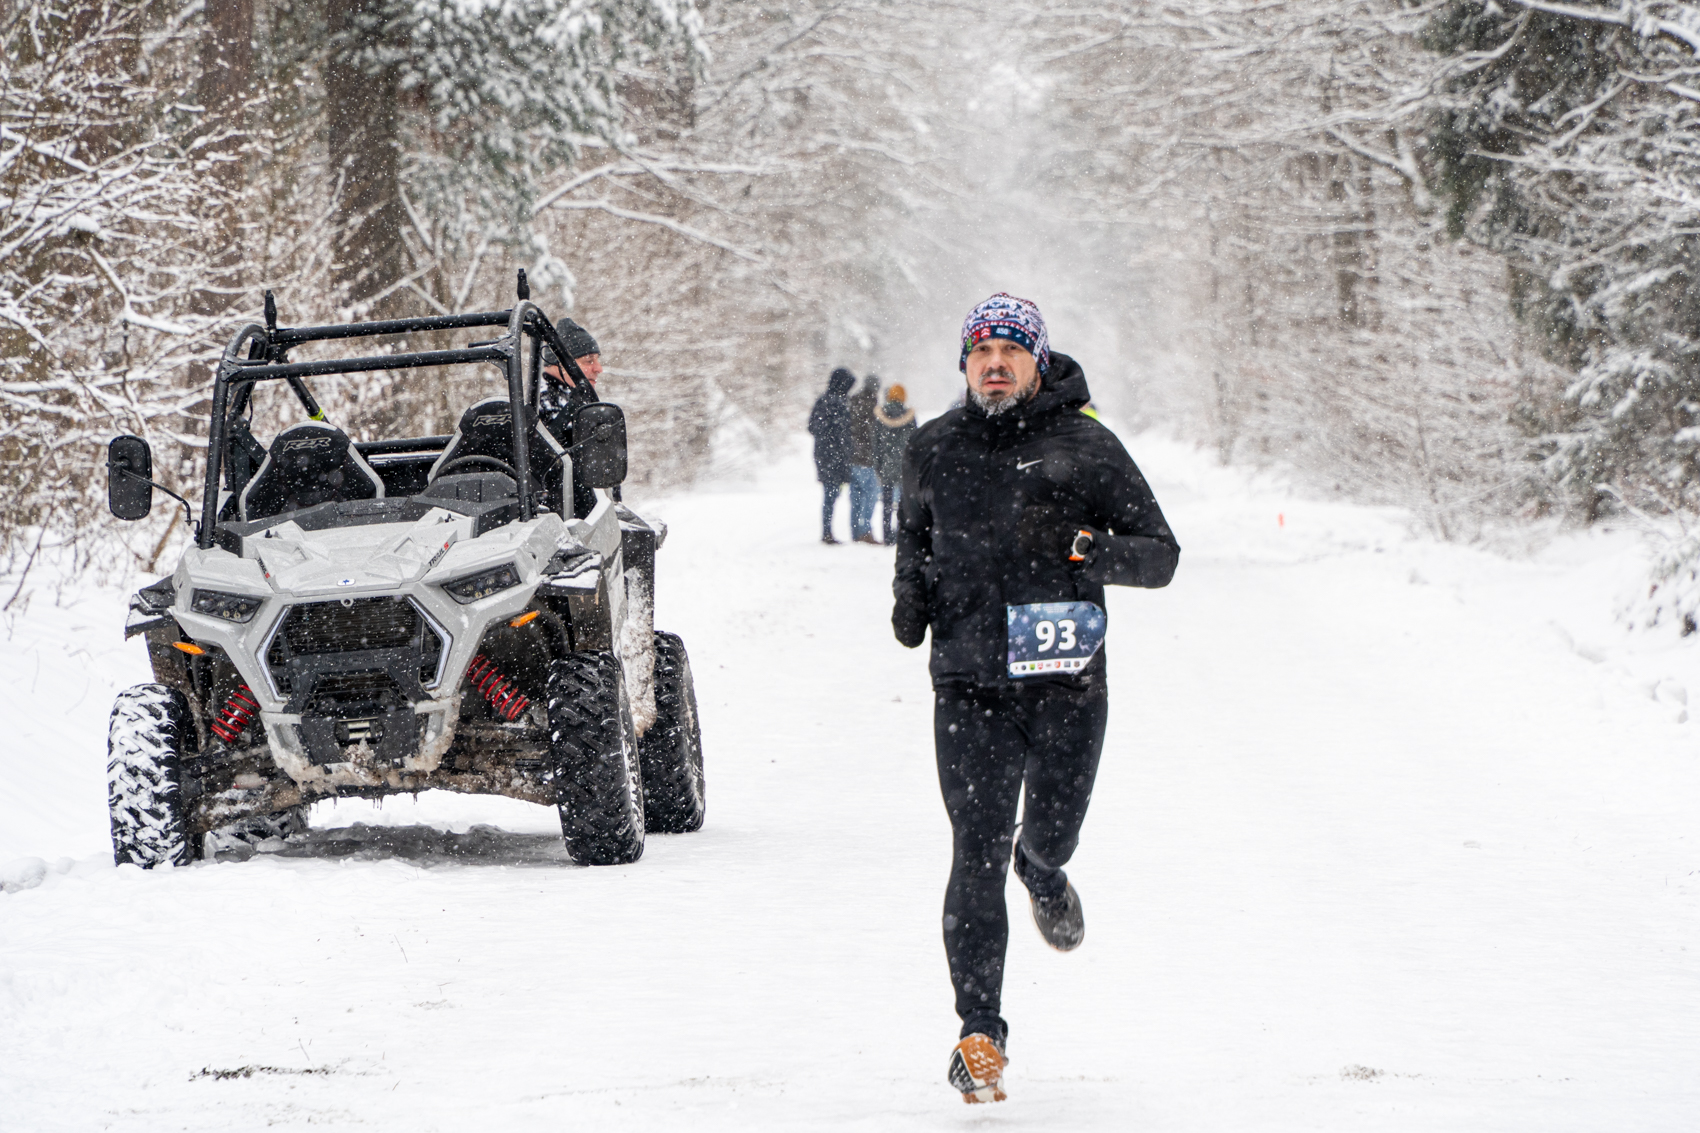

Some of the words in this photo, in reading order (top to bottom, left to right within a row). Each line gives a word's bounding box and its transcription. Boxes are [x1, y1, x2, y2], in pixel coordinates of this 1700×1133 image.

[283, 436, 331, 452] RZR
[428, 547, 445, 567] TRAIL
[1036, 620, 1076, 652] 93
